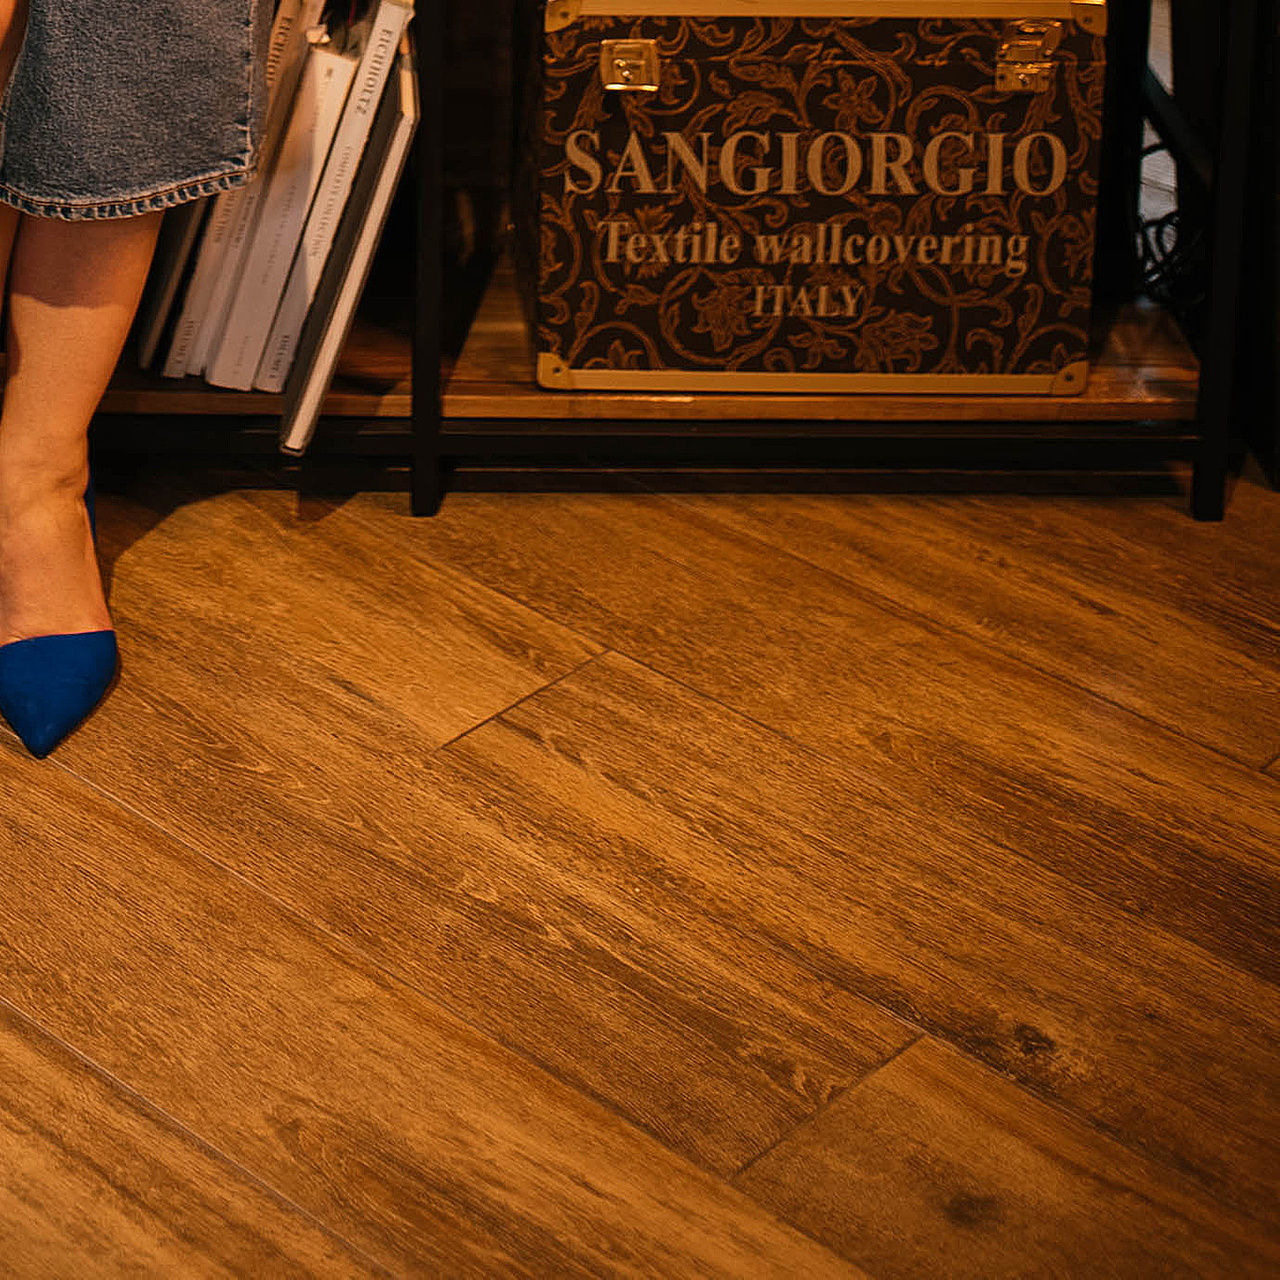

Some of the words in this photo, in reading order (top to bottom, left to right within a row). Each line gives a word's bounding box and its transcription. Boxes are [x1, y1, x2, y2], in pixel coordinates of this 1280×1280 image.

[265, 14, 293, 87] EICHHOL
[354, 26, 395, 118] EICHHOLTZ
[563, 129, 1070, 197] SANGIORGIO
[596, 220, 740, 265] Textile
[755, 222, 1031, 276] wallcovering
[752, 284, 867, 318] ITALY
